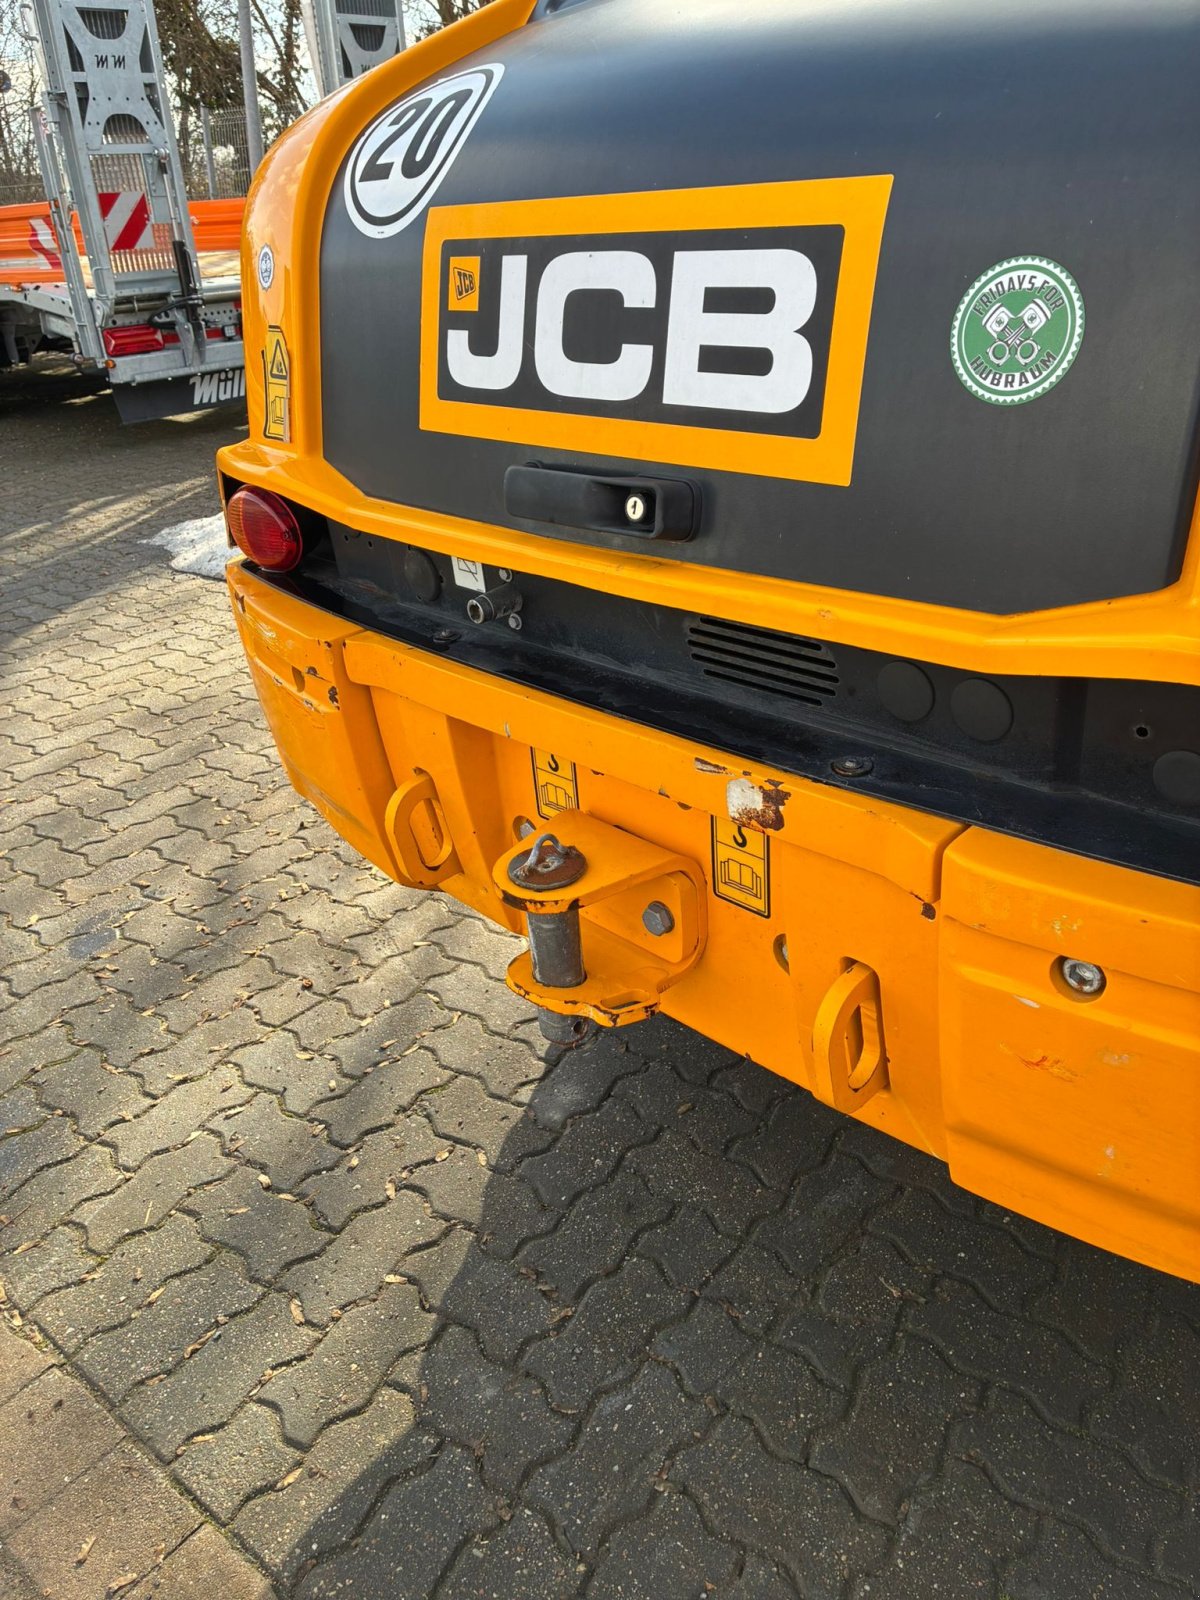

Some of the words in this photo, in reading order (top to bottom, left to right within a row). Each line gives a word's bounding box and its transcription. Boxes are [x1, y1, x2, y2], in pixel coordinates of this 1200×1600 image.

[358, 88, 474, 183] 20
[456, 270, 475, 297] JCB
[972, 274, 1037, 316] FRIDAYS
[1036, 279, 1066, 312] FOR
[447, 248, 818, 414] JCB
[969, 351, 1058, 389] HUBRAUM
